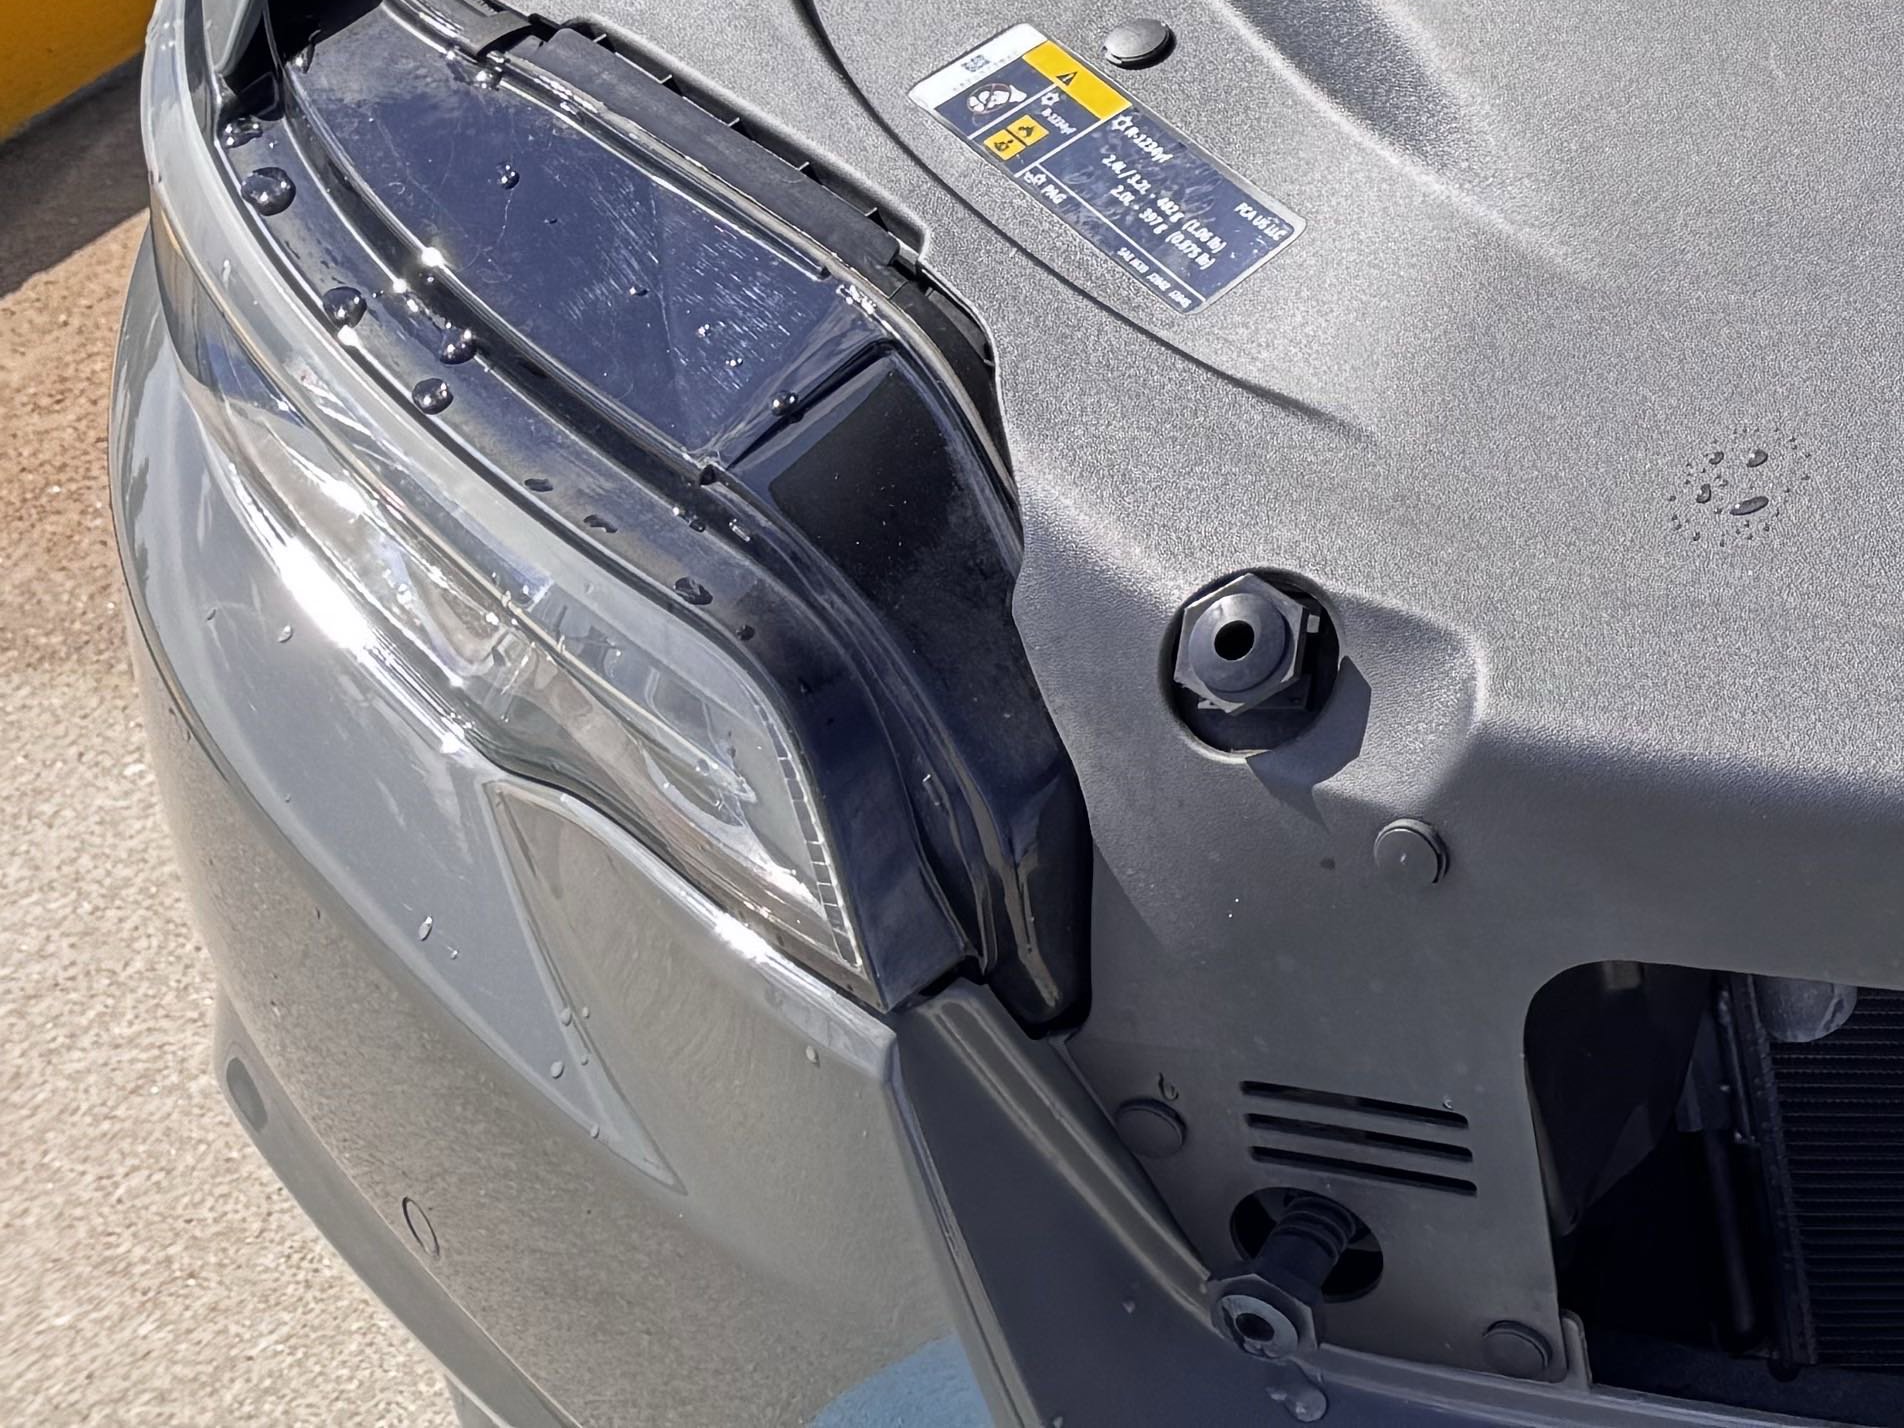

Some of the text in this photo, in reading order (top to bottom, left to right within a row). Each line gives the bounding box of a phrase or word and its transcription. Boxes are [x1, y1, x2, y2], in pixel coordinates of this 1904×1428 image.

[1124, 126, 1174, 163] R-1234yf
[1041, 184, 1067, 204] PAG
[1234, 202, 1288, 241] FCA US LLC
